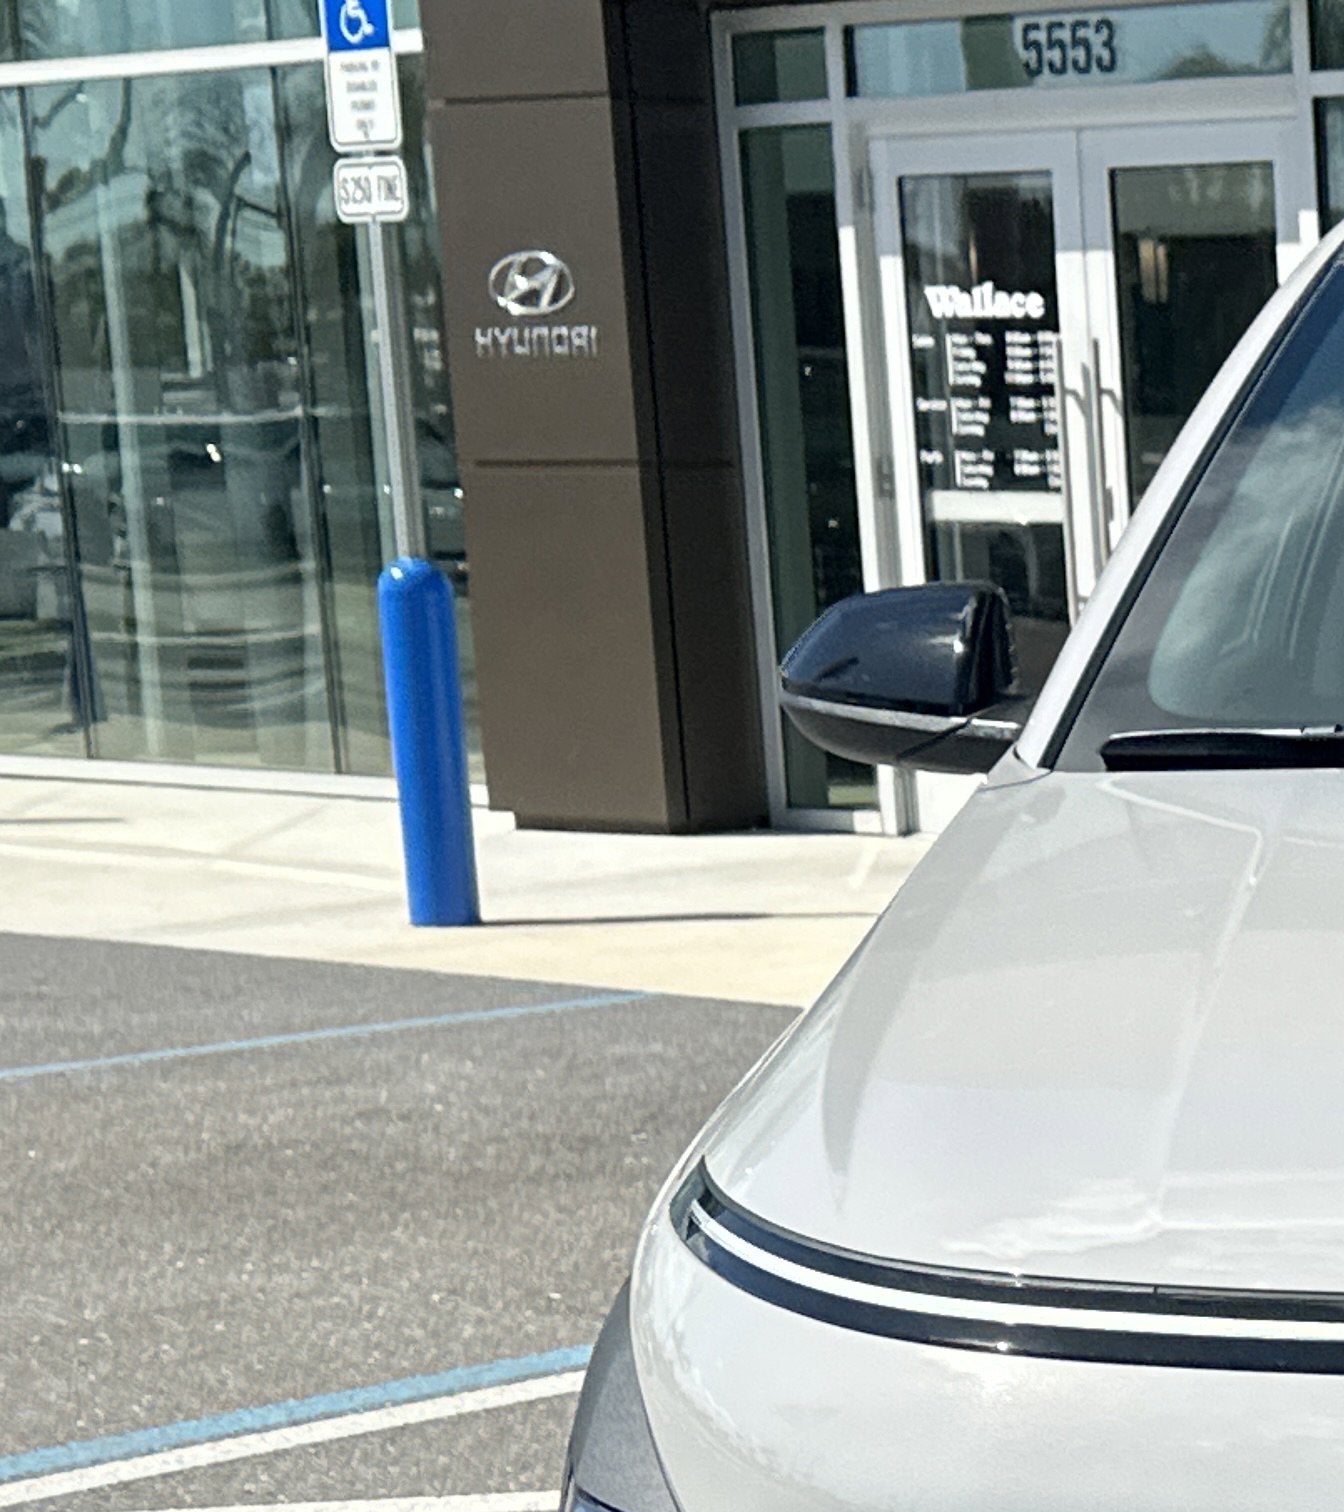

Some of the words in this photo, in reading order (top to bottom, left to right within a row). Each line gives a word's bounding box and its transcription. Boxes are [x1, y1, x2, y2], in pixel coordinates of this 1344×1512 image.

[1021, 18, 1117, 78] 5553
[924, 280, 1046, 319] Wallace
[474, 324, 598, 359] HYUNDAI
